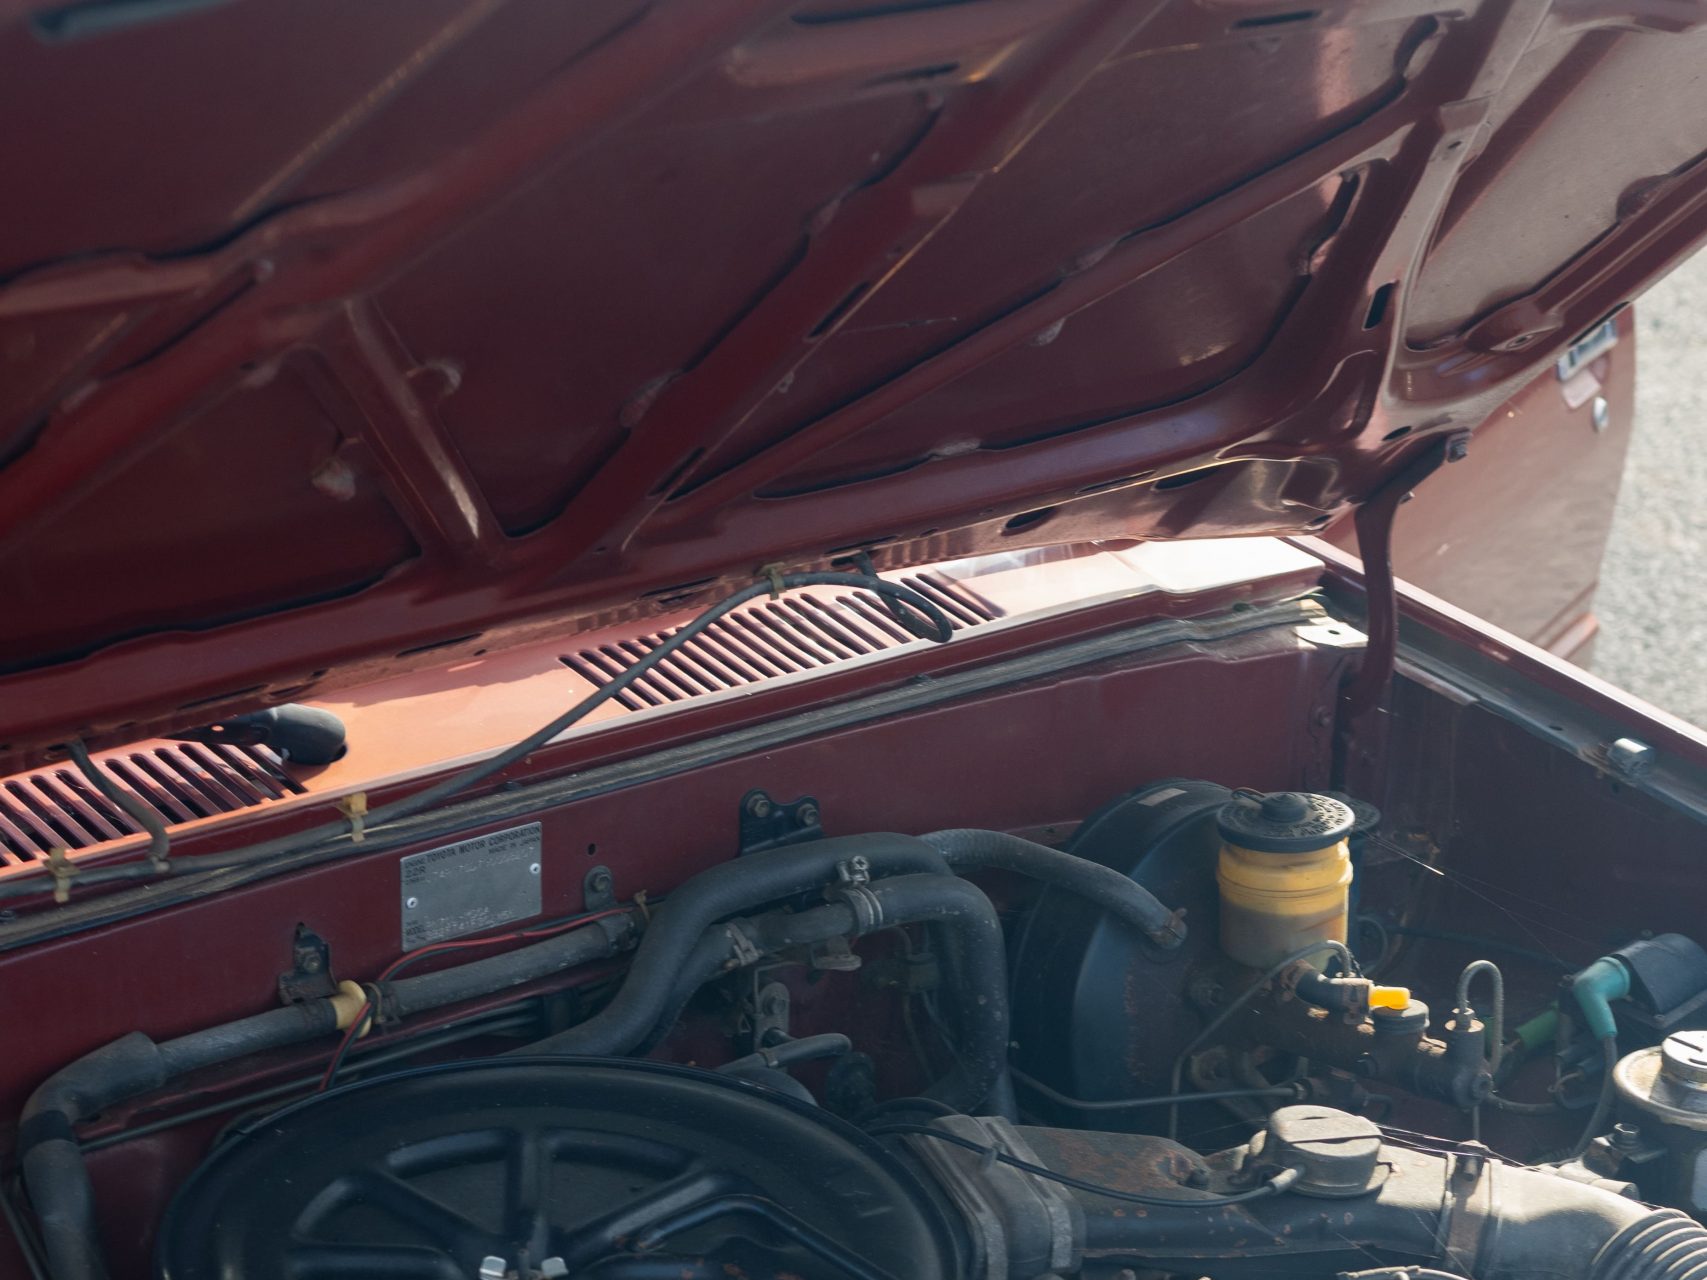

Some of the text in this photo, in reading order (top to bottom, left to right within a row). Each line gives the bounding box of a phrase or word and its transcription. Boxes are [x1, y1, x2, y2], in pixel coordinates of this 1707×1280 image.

[426, 848, 456, 863] TOYOTA
[458, 840, 486, 854] MOTOR
[488, 826, 541, 846] CORPORATION
